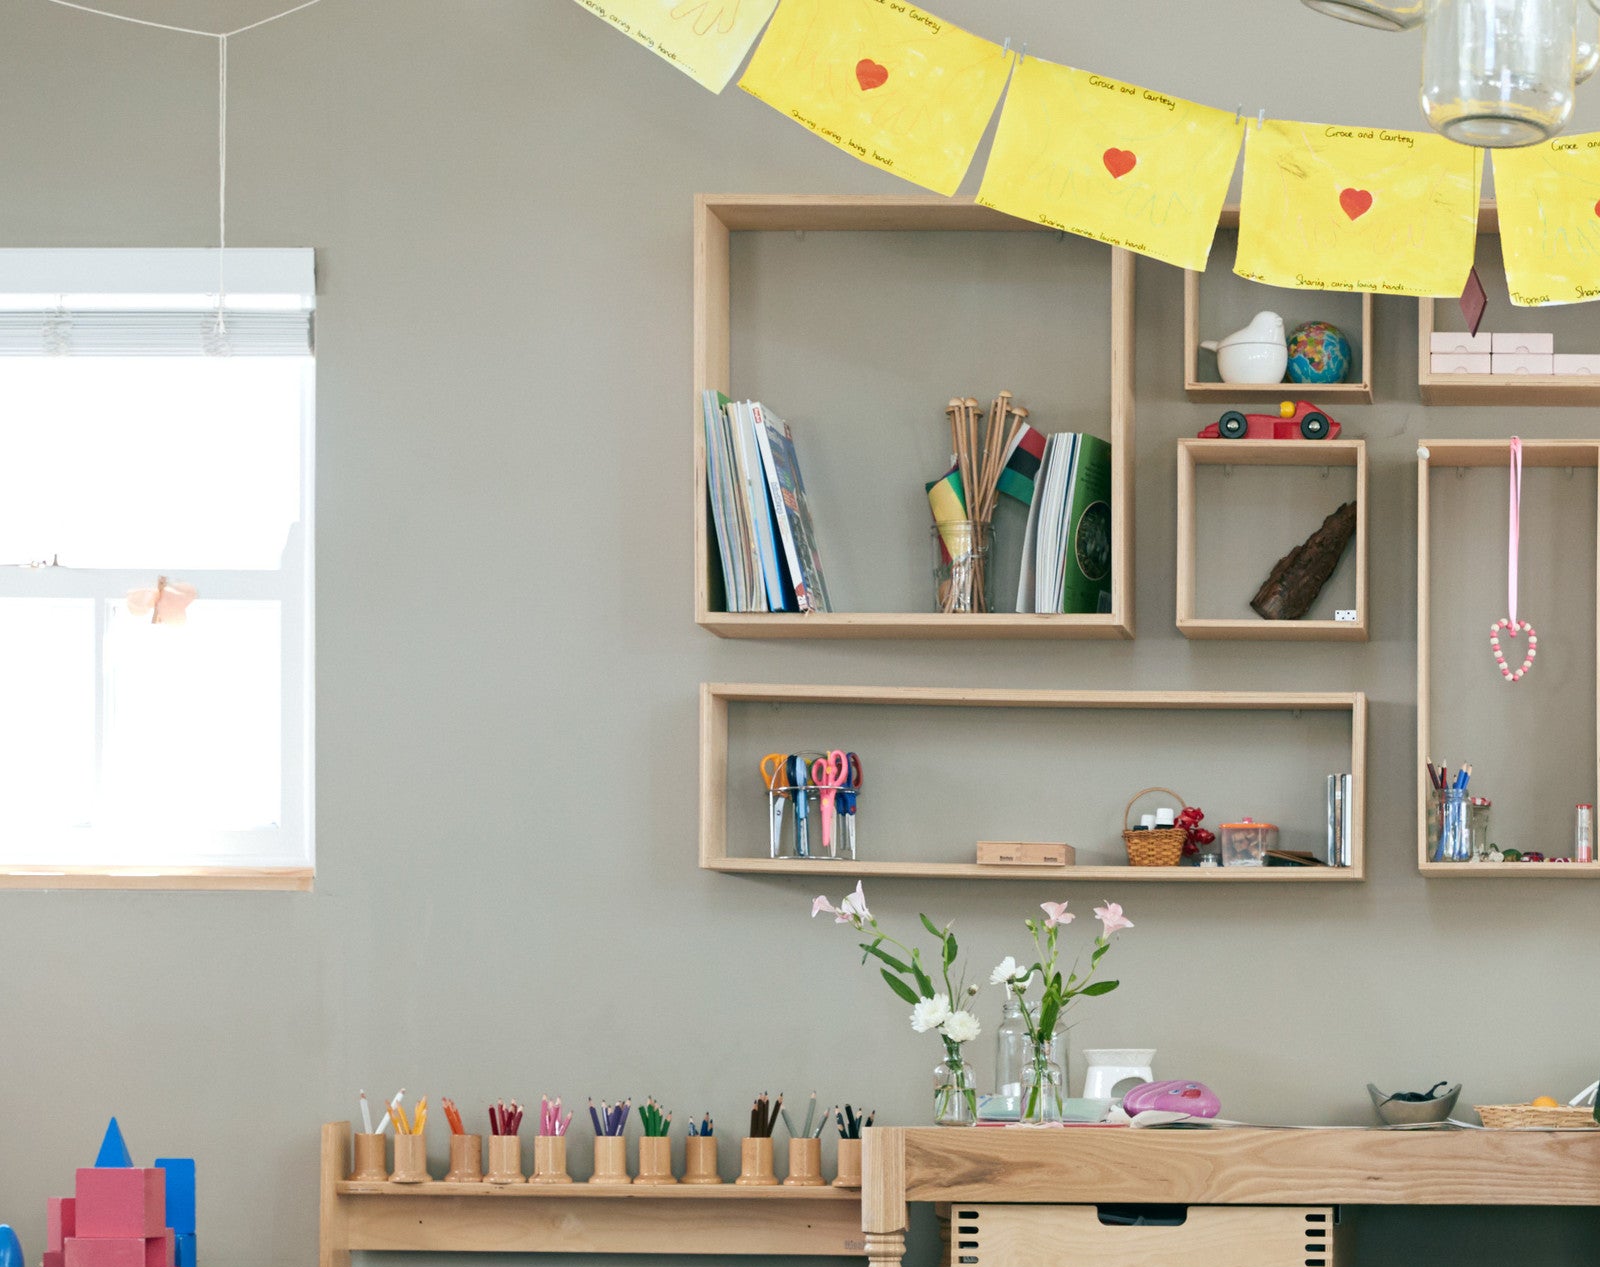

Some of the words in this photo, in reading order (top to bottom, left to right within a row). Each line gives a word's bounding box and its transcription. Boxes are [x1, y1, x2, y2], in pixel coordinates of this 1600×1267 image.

[890, 3, 906, 13] and
[909, 9, 941, 34] Courtesy
[1089, 75, 1115, 90] Grace
[1120, 86, 1136, 95] and
[1143, 90, 1176, 111] Courtesy
[1325, 127, 1354, 138] Grace
[1380, 130, 1414, 148] Courtesy
[1551, 140, 1578, 152] Grace
[1511, 292, 1550, 305] Thomas
